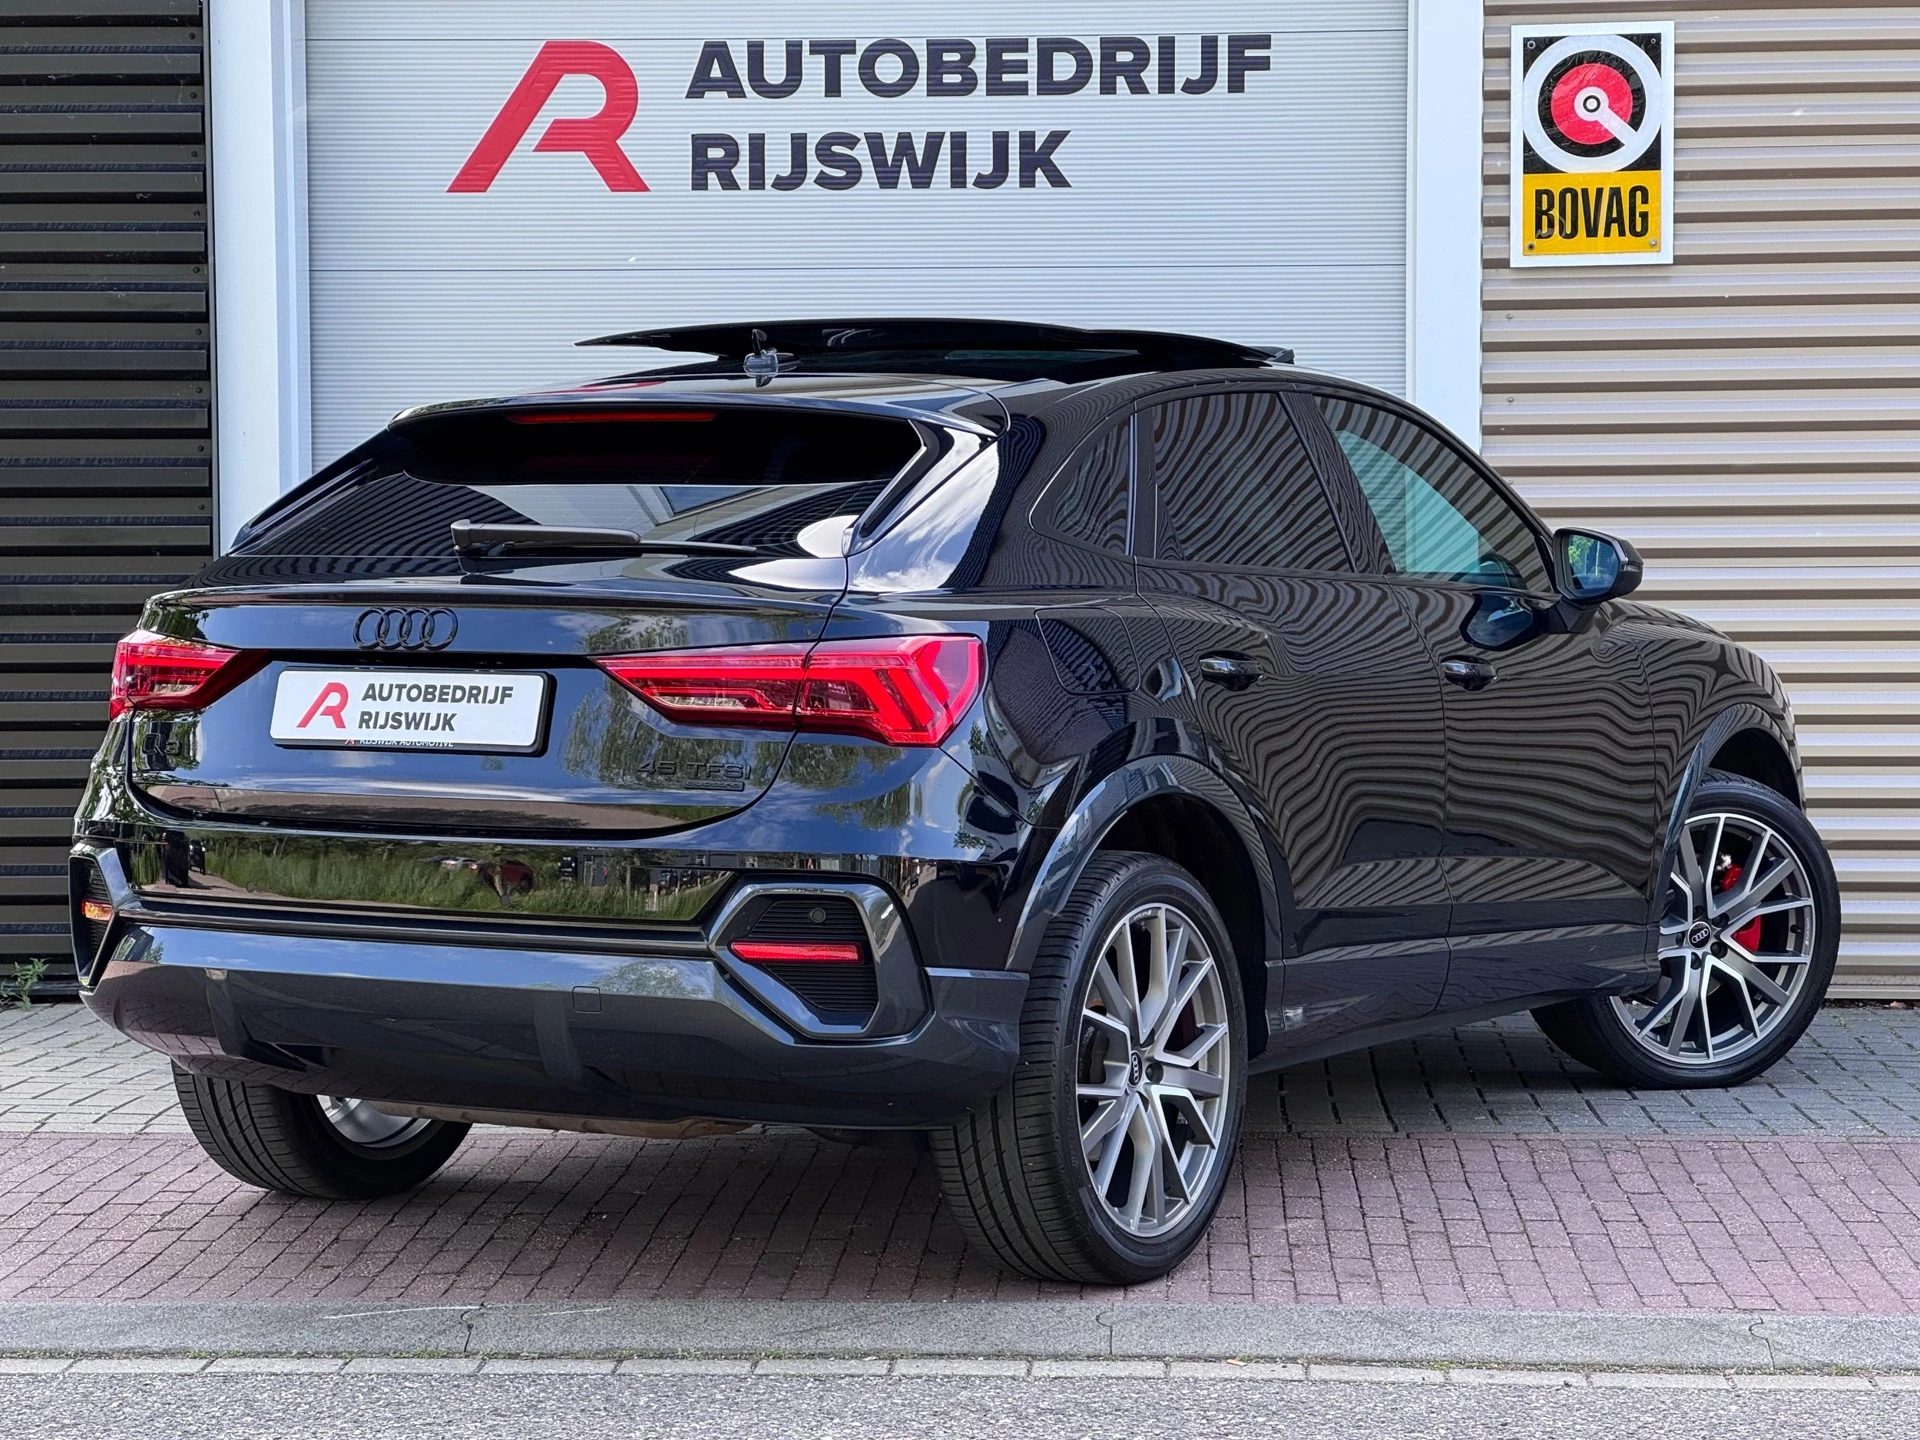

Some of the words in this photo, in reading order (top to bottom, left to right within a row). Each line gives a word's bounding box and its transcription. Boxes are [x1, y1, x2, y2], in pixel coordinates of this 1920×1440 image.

[685, 34, 1272, 99] AUTOBEDRIJF
[691, 130, 1073, 191] RIJSWIJK
[1534, 185, 1650, 240] BOVAG
[361, 683, 514, 705] AUTOBEDRIJF
[358, 711, 457, 732] RIJSWIJK
[637, 759, 677, 776] 45
[686, 761, 752, 780] TFSI
[685, 780, 742, 790] quattro
